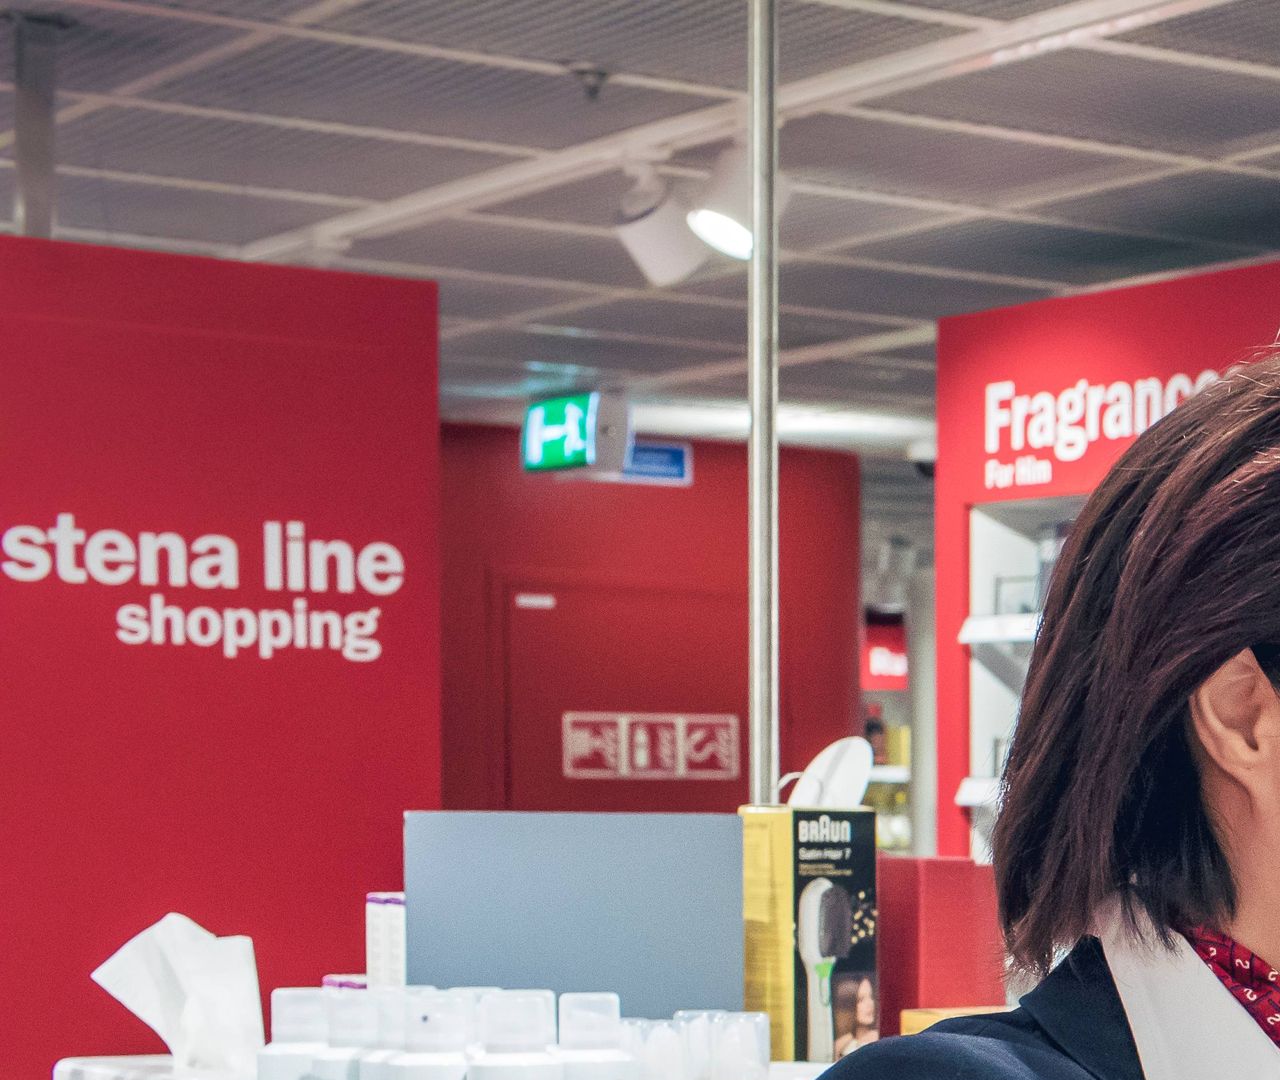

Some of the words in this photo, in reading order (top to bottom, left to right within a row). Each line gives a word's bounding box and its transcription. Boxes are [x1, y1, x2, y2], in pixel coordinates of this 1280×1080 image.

[984, 368, 1230, 462] Fragranc
[984, 459, 1014, 489] For
[1, 512, 239, 590] stena
[263, 520, 404, 595] line
[116, 593, 382, 662] shopping
[799, 814, 851, 843] BRAUN
